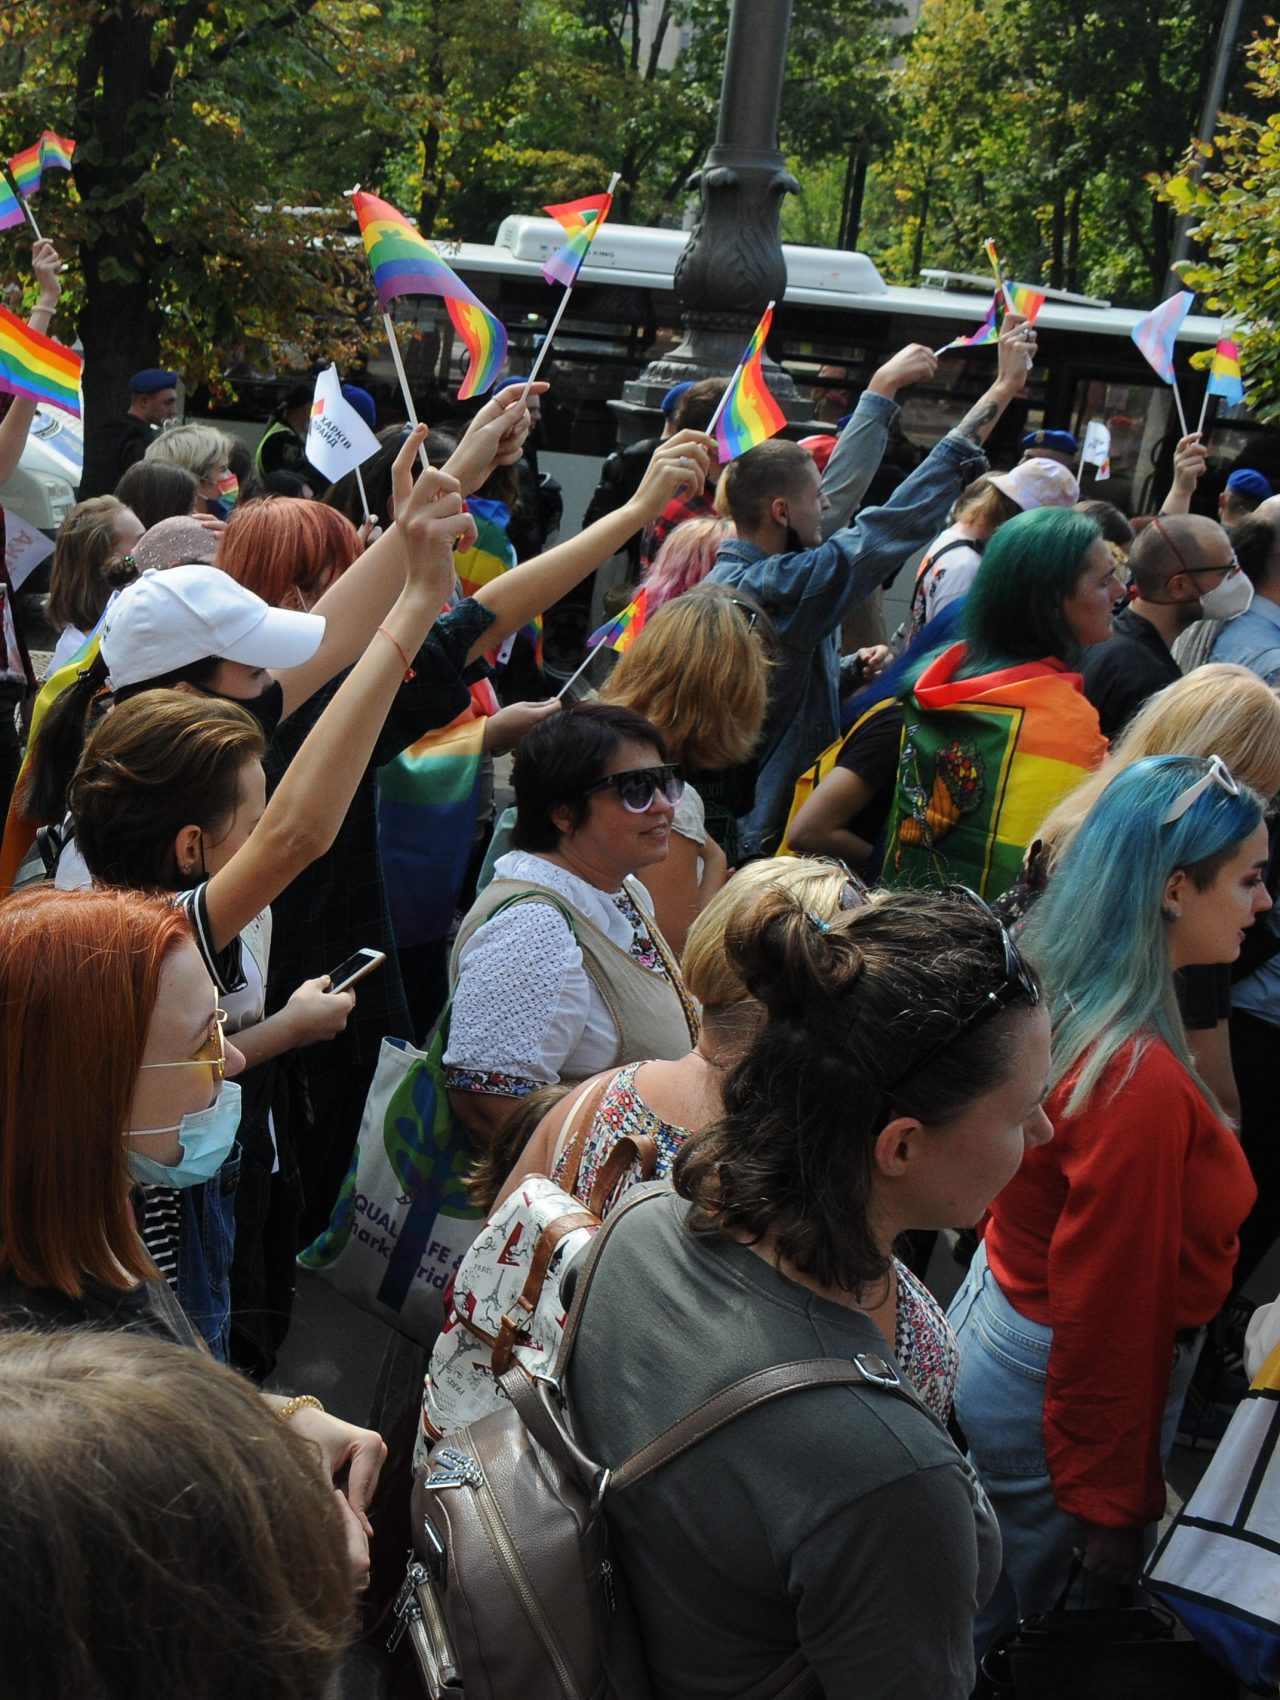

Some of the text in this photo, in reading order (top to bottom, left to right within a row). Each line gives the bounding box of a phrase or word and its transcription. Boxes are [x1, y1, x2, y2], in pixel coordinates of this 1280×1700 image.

[320, 416, 351, 449] ХАРКІВ
[352, 1189, 397, 1238] QUAL
[426, 1240, 451, 1264] FE
[416, 1266, 450, 1290] rid
[473, 1263, 492, 1275] PARIS
